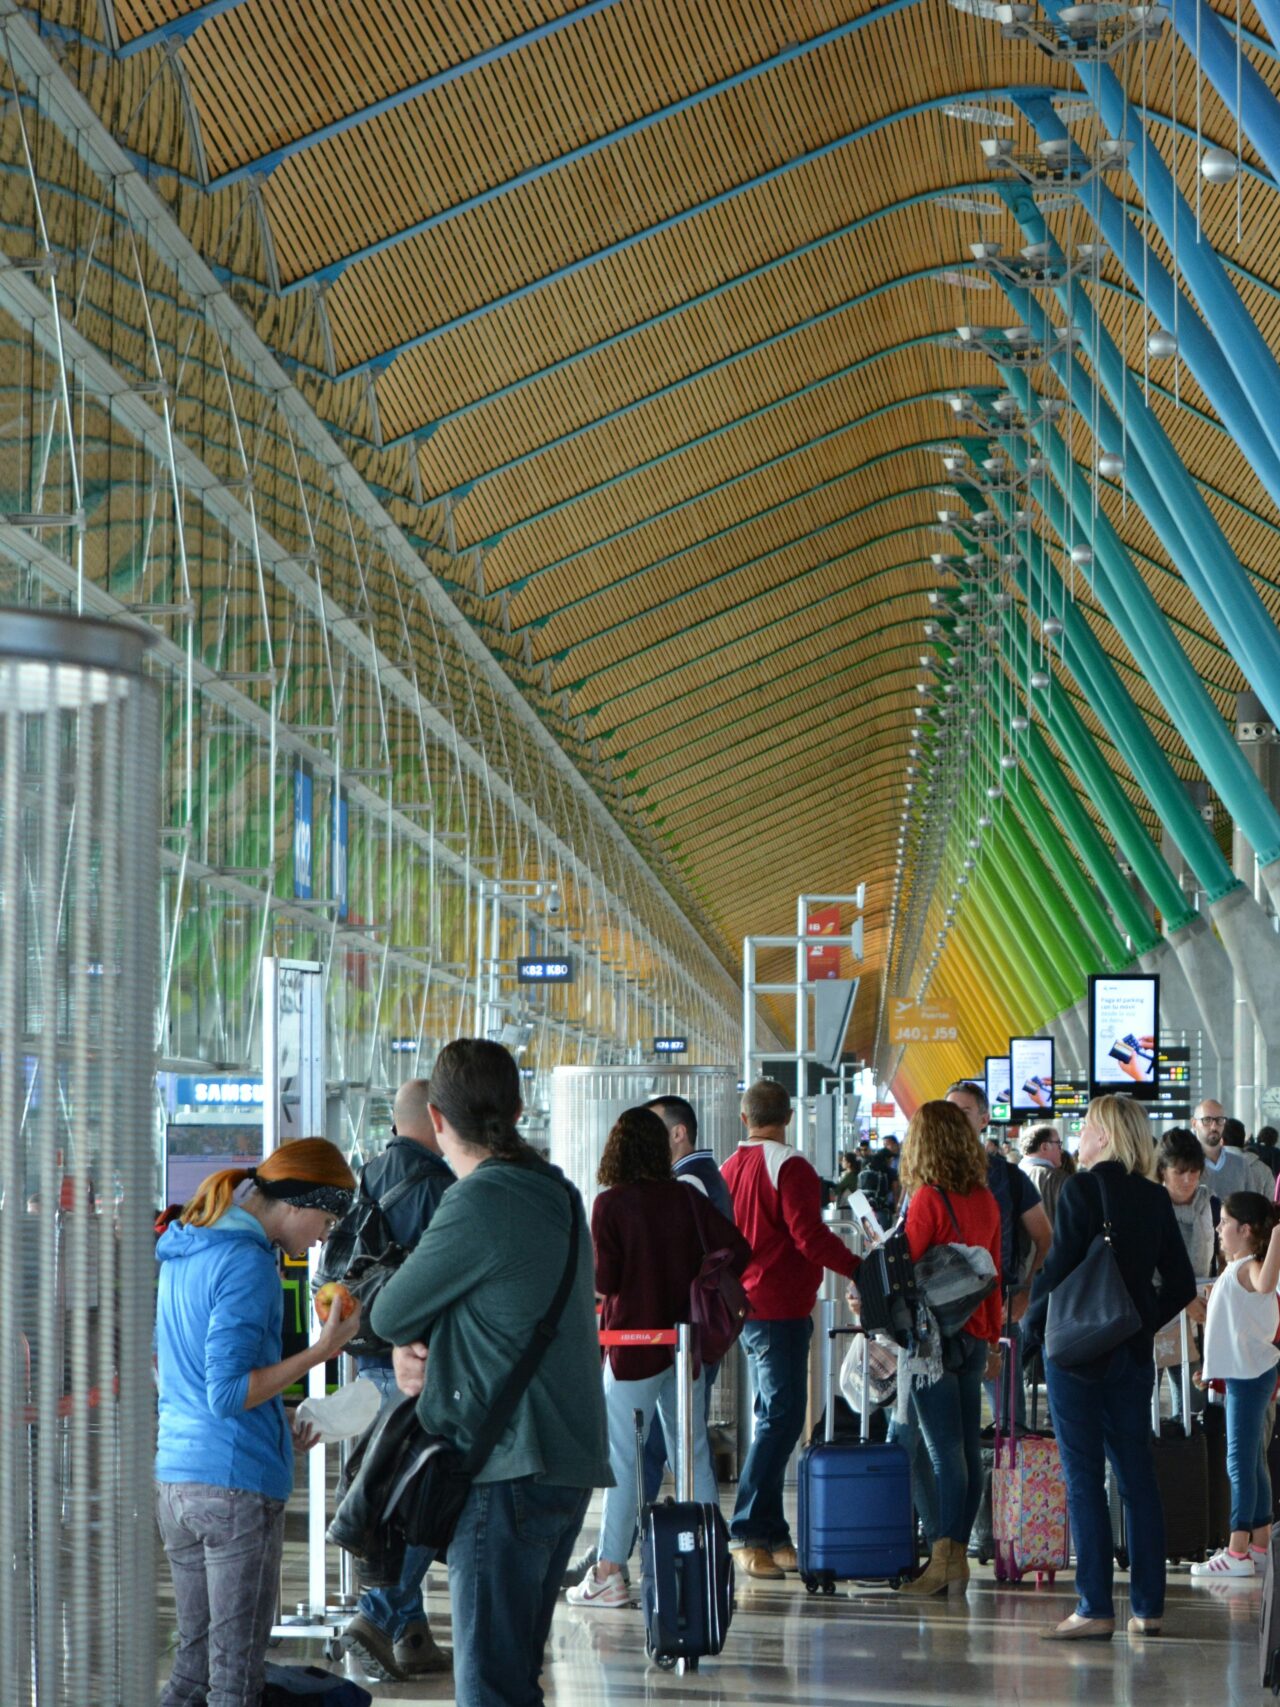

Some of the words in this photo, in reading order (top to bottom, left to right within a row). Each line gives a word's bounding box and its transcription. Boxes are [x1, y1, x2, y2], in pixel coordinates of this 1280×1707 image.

[522, 965, 543, 976] K82
[546, 964, 568, 975] K80
[896, 1027, 921, 1040] J40
[932, 1027, 958, 1040] J59
